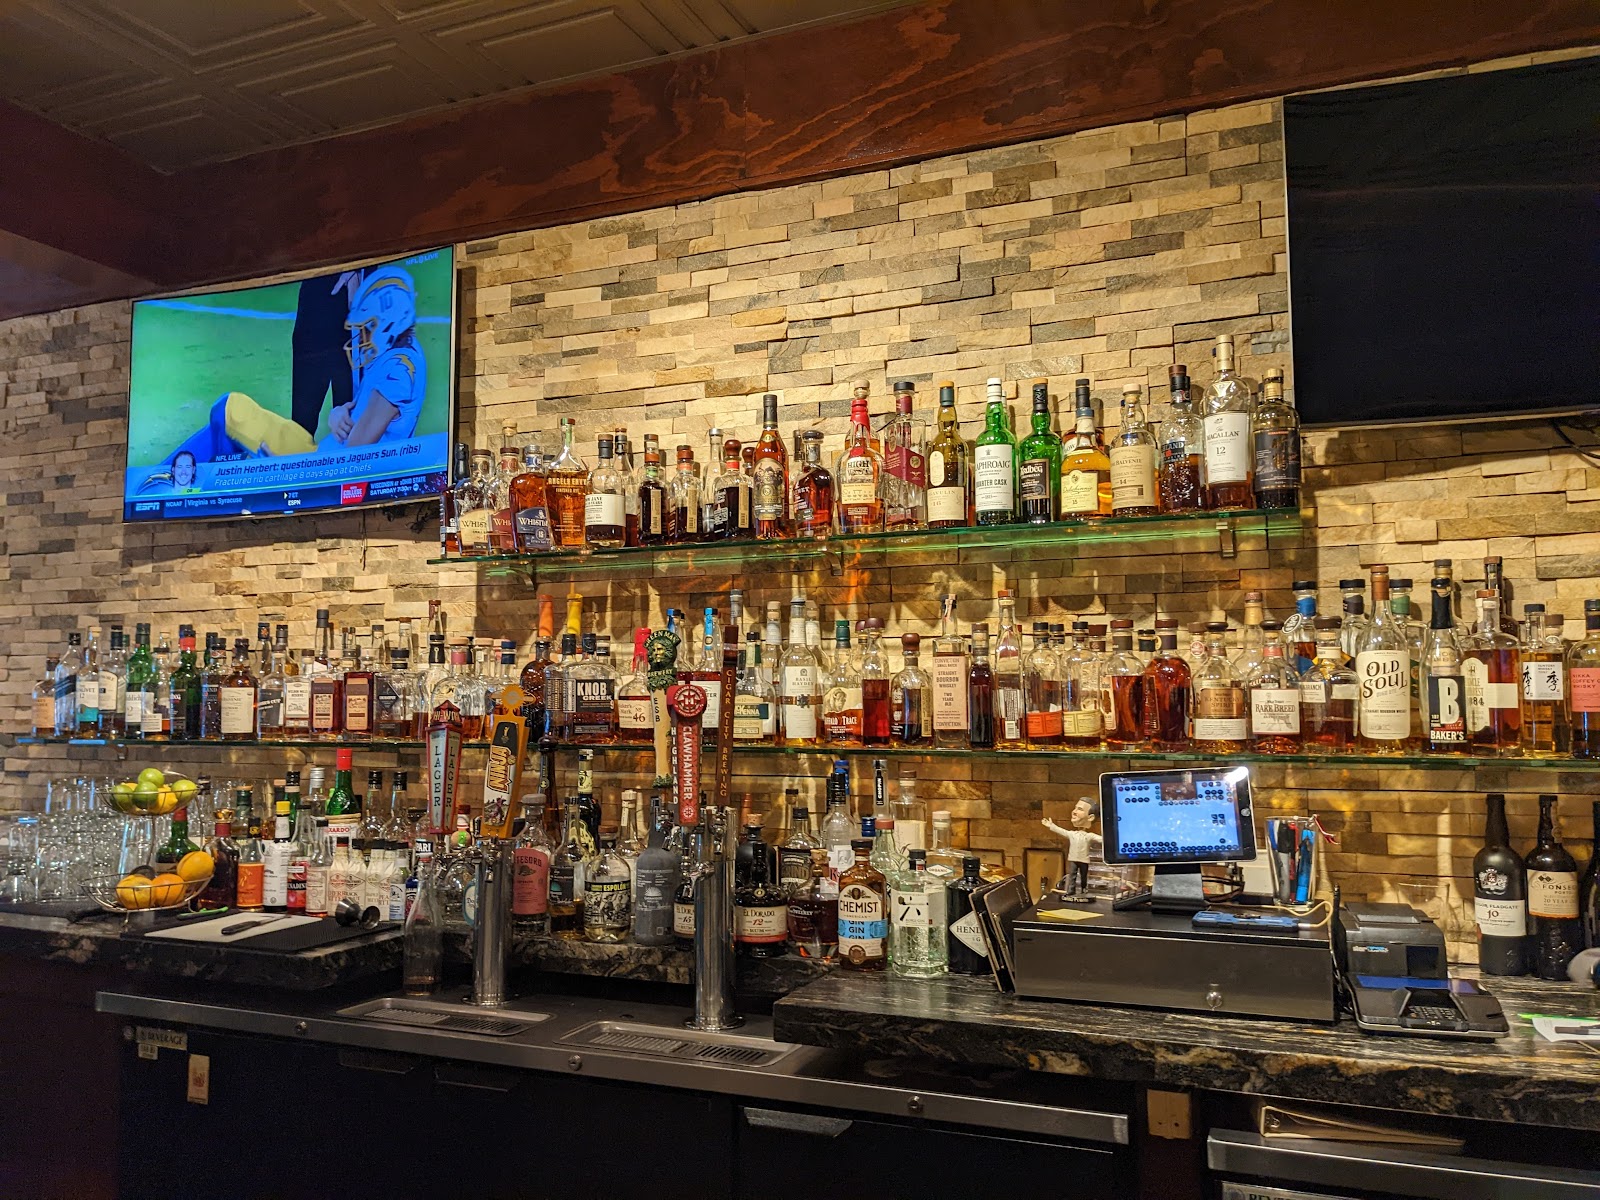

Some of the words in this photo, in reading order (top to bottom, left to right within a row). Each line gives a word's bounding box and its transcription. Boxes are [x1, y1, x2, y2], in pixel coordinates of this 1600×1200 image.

[1216, 446, 1226, 455] 12
[216, 465, 242, 476] Justin
[243, 462, 279, 474] Herbert:
[281, 456, 335, 472] questionable
[336, 456, 346, 464] vs
[347, 450, 380, 463] Jaguars
[380, 448, 398, 458] Sun.
[400, 443, 421, 457] (ribs)
[847, 460, 870, 468] HIGH
[214, 477, 252, 486] Fractured
[253, 475, 263, 483] rib
[265, 471, 298, 483] cartilage
[305, 469, 323, 479] days
[324, 468, 339, 477] ago
[348, 463, 372, 473] Chiefs
[369, 487, 396, 496] SATURDAY
[135, 502, 160, 511] ESPN
[1366, 659, 1400, 677] OLD
[577, 682, 607, 696] KNOB
[1362, 671, 1408, 699] SOUL
[1255, 703, 1273, 713] RARE
[1274, 703, 1295, 712] BREED
[1438, 678, 1460, 725] B
[633, 713, 646, 723] 46
[842, 715, 858, 725] TRACE
[723, 711, 731, 740] CITY
[1430, 730, 1464, 740] BAKER'S
[671, 726, 679, 805] HIGHLAND
[683, 725, 693, 800] CLAWHAMMER
[433, 745, 442, 807] LAGER
[445, 746, 456, 808] LAGER
[720, 747, 729, 797] BREWING
[743, 908, 750, 917] EL
[750, 909, 775, 918] DORADO
[840, 901, 879, 913] CHEMIST
[752, 918, 764, 926] 12
[848, 926, 865, 934] GIN
